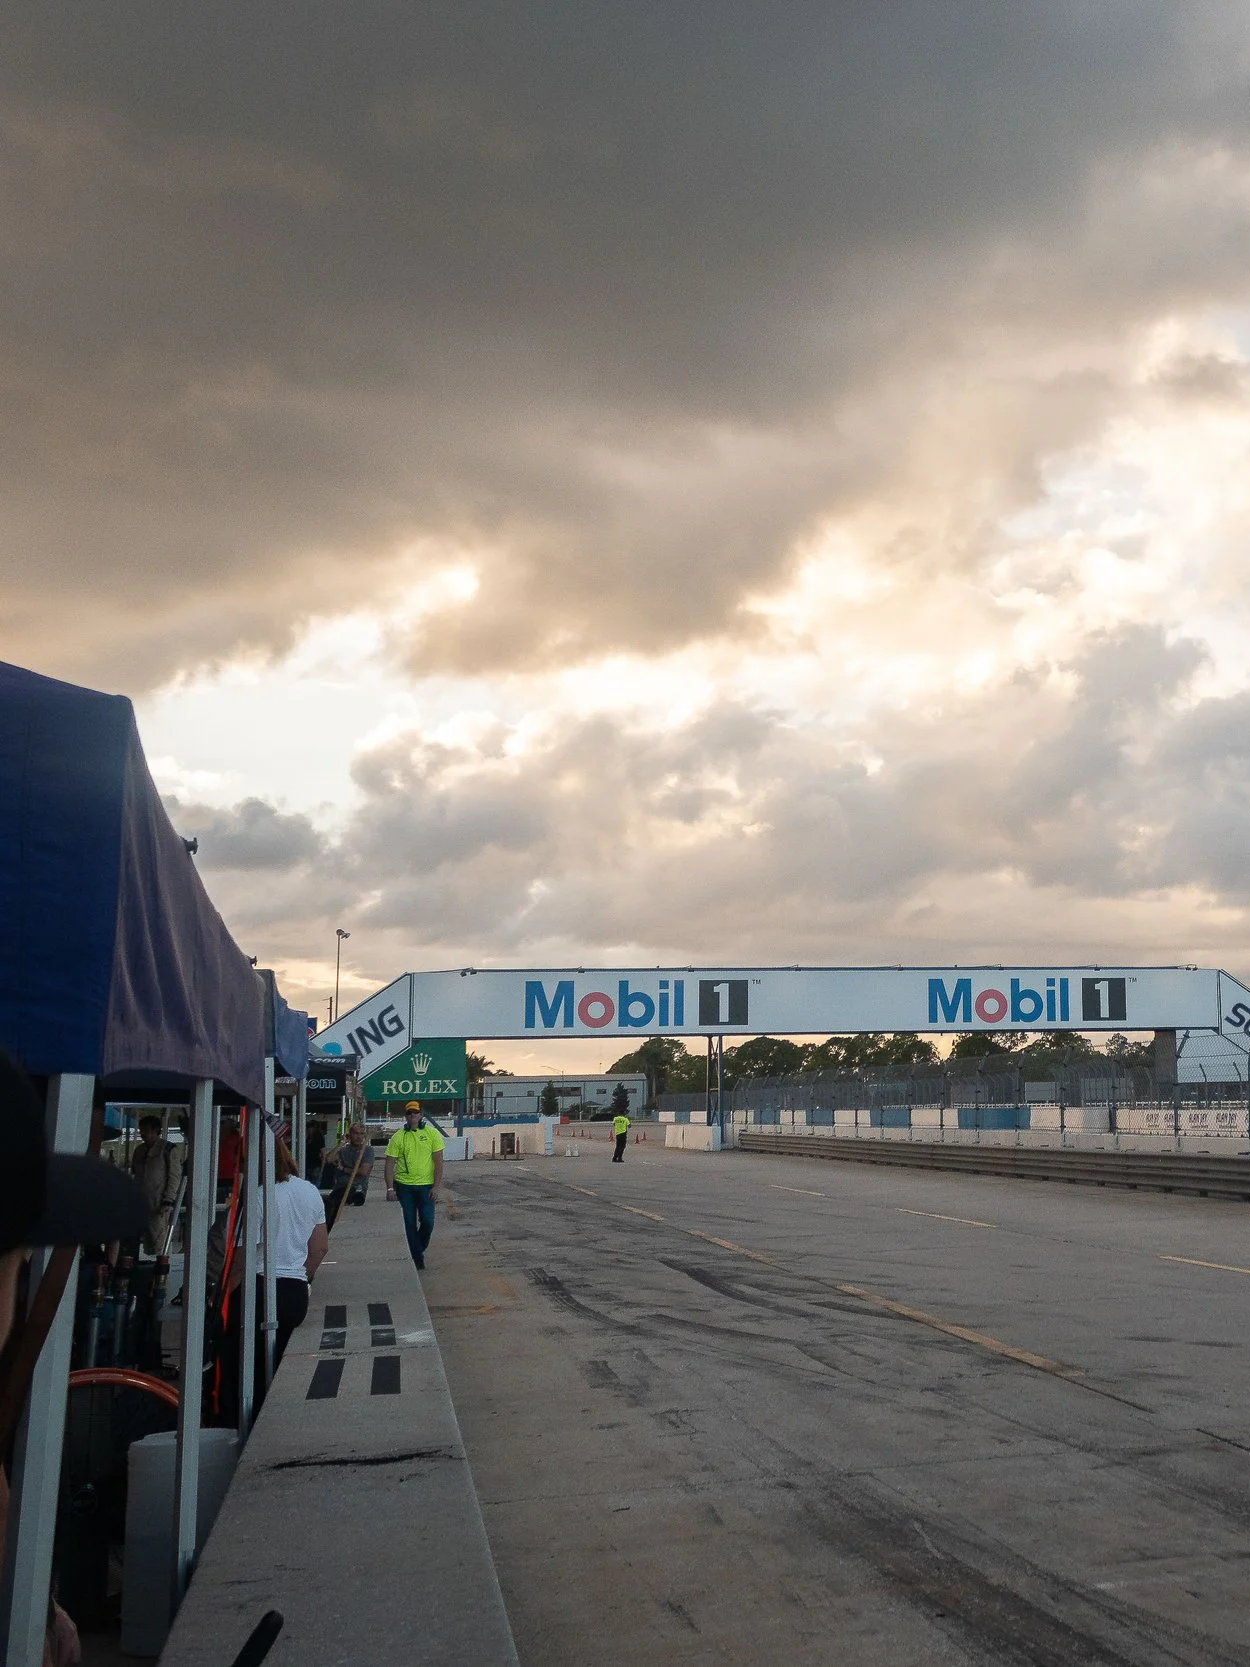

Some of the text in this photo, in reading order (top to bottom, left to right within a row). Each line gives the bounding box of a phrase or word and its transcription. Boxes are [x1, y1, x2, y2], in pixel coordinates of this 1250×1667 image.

[524, 979, 685, 1029] Mobil
[928, 977, 1069, 1024] Mobil
[306, 1079, 337, 1089] om
[381, 1080, 458, 1095] ROLEX
